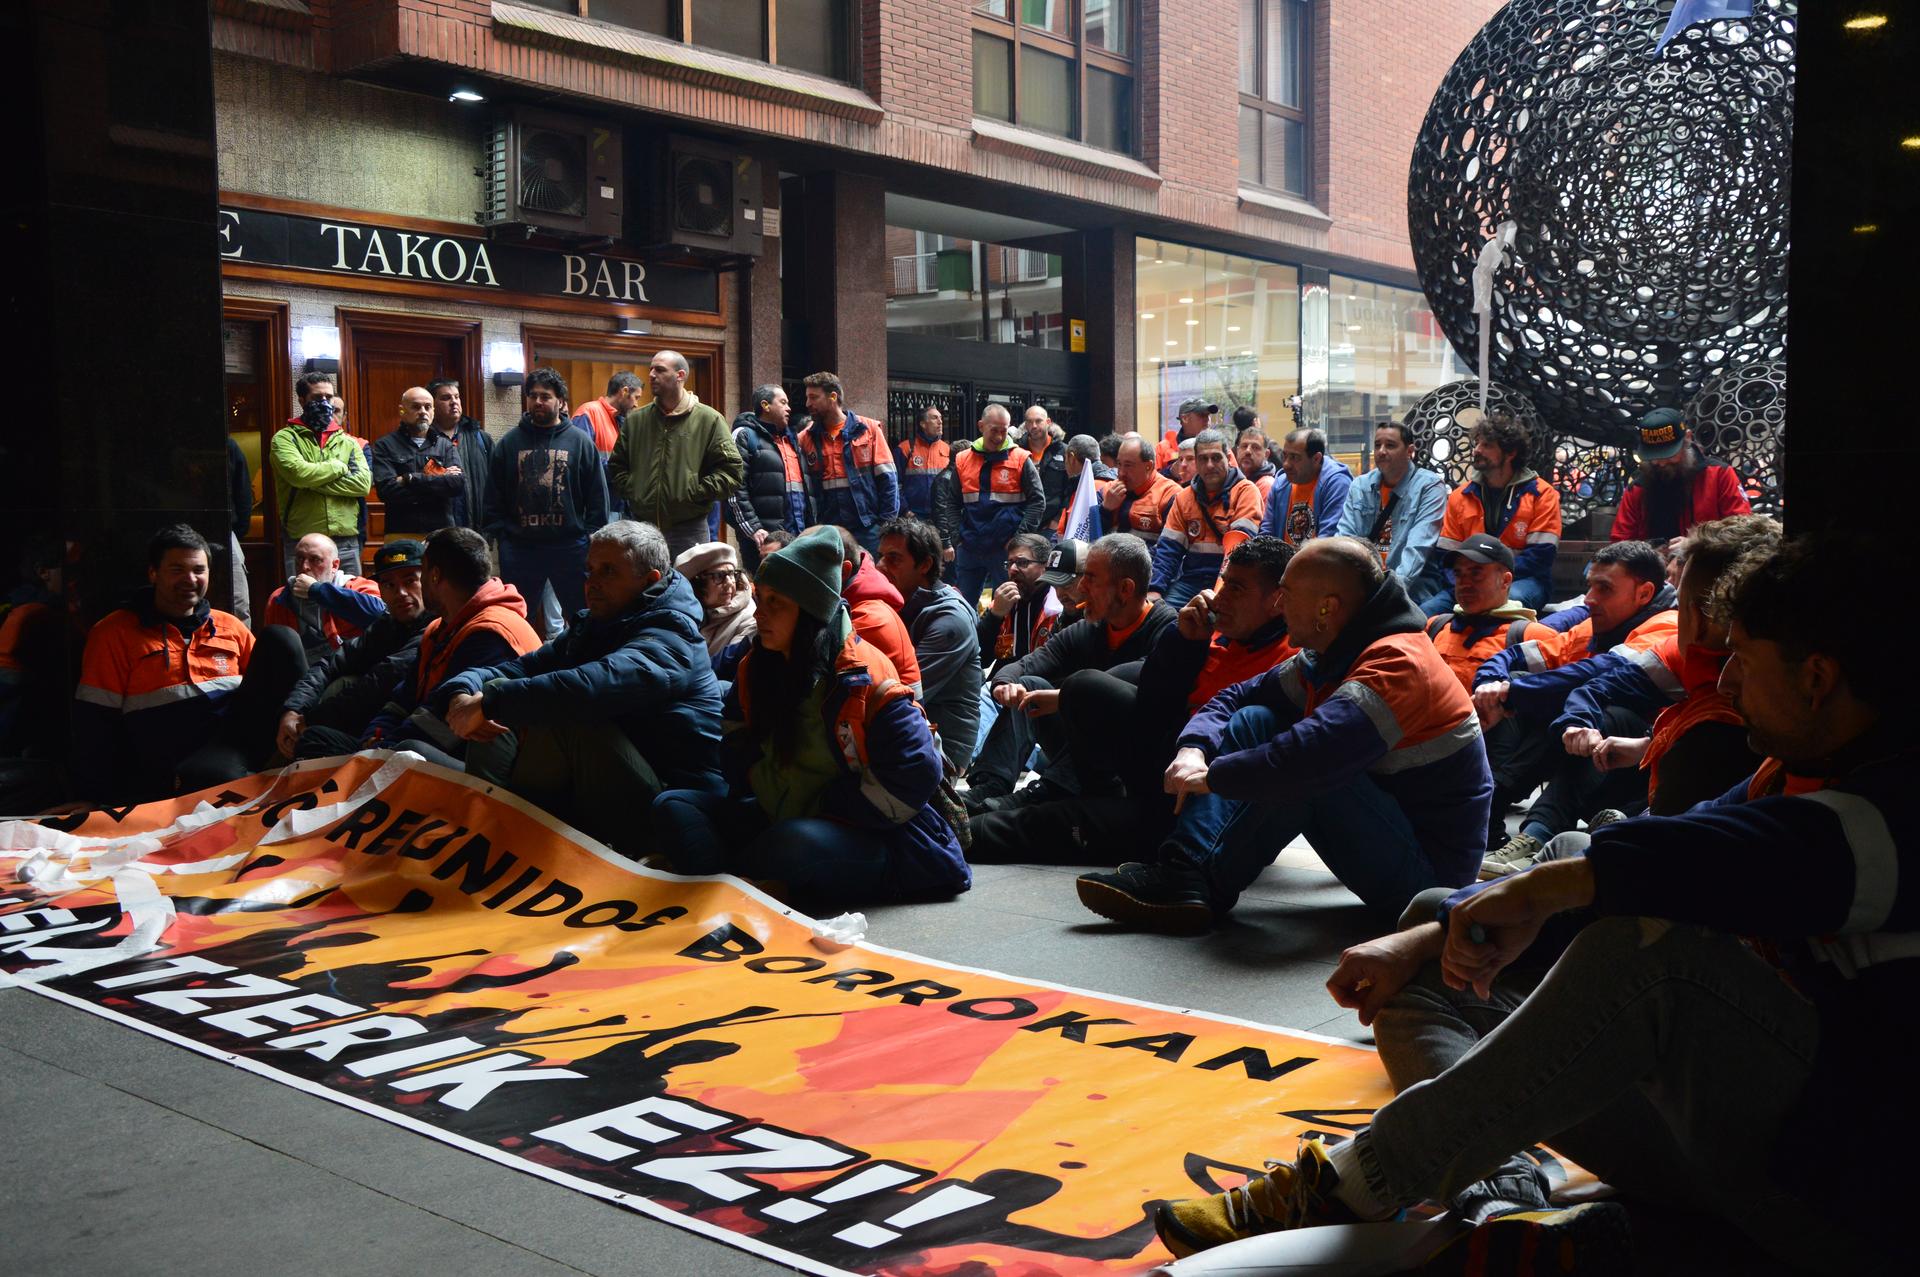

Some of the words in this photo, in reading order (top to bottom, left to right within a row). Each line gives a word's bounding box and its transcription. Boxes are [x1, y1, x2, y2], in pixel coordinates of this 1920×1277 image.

[320, 223, 500, 286] TAKOA
[562, 254, 650, 302] BAR
[325, 798, 689, 932] REUNIDOS
[676, 921, 1319, 1082] BORROKAN
[530, 1096, 996, 1249] EZ!!
